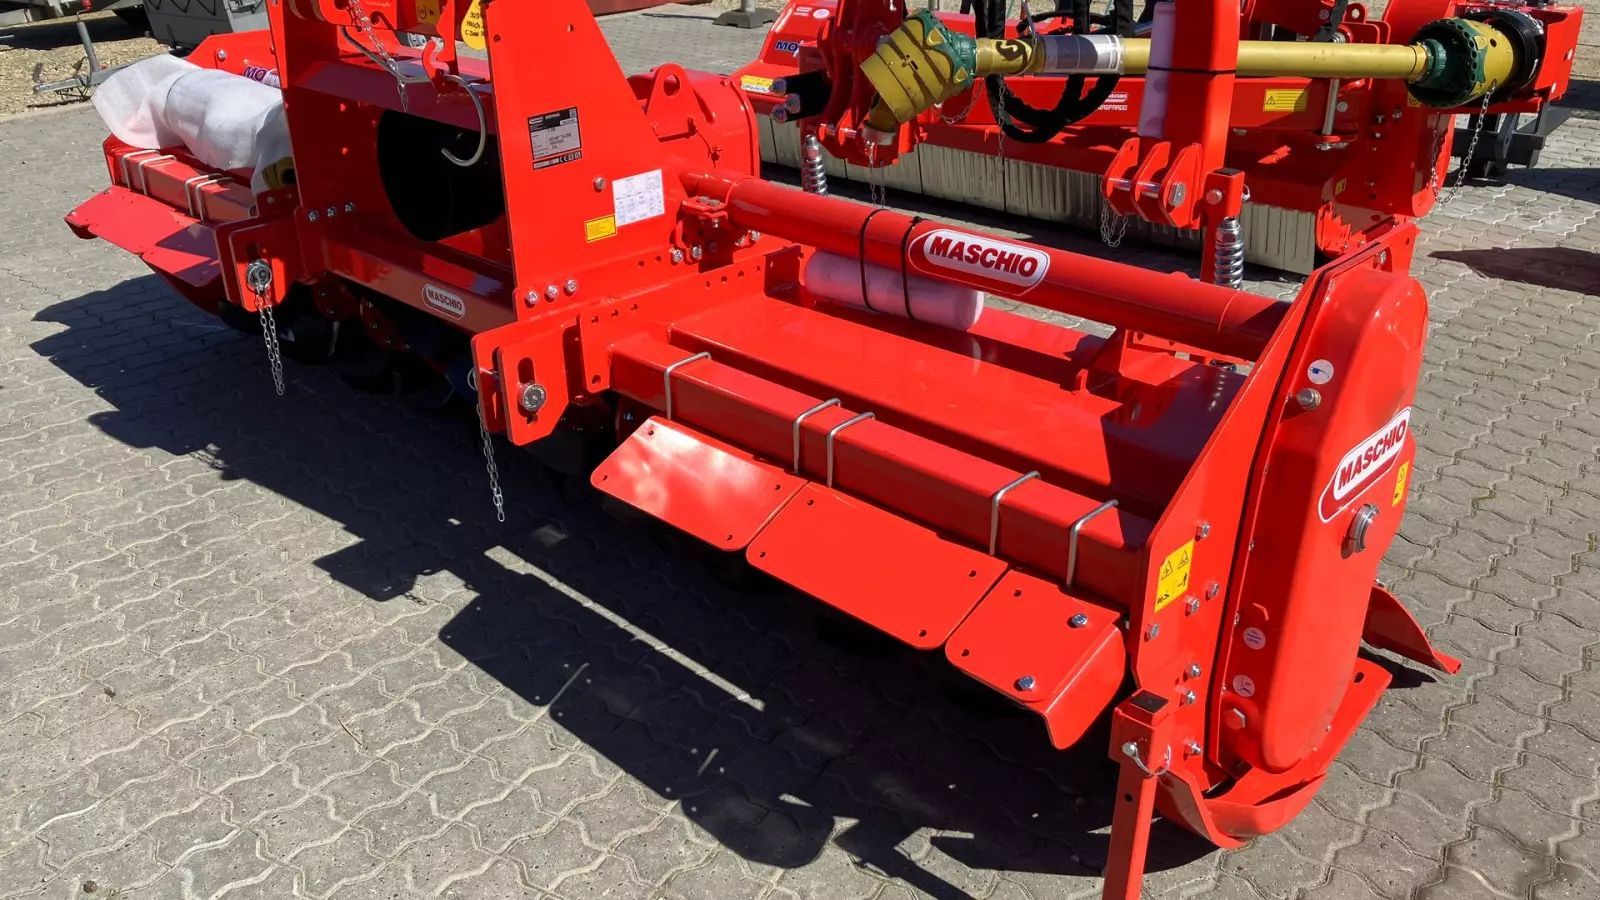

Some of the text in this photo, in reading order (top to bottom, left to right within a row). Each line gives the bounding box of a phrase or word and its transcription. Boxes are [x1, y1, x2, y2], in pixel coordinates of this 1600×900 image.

[929, 235, 1039, 278] MASCHIO
[427, 288, 463, 311] MASCHIO
[1337, 419, 1407, 491] MASCHIO
